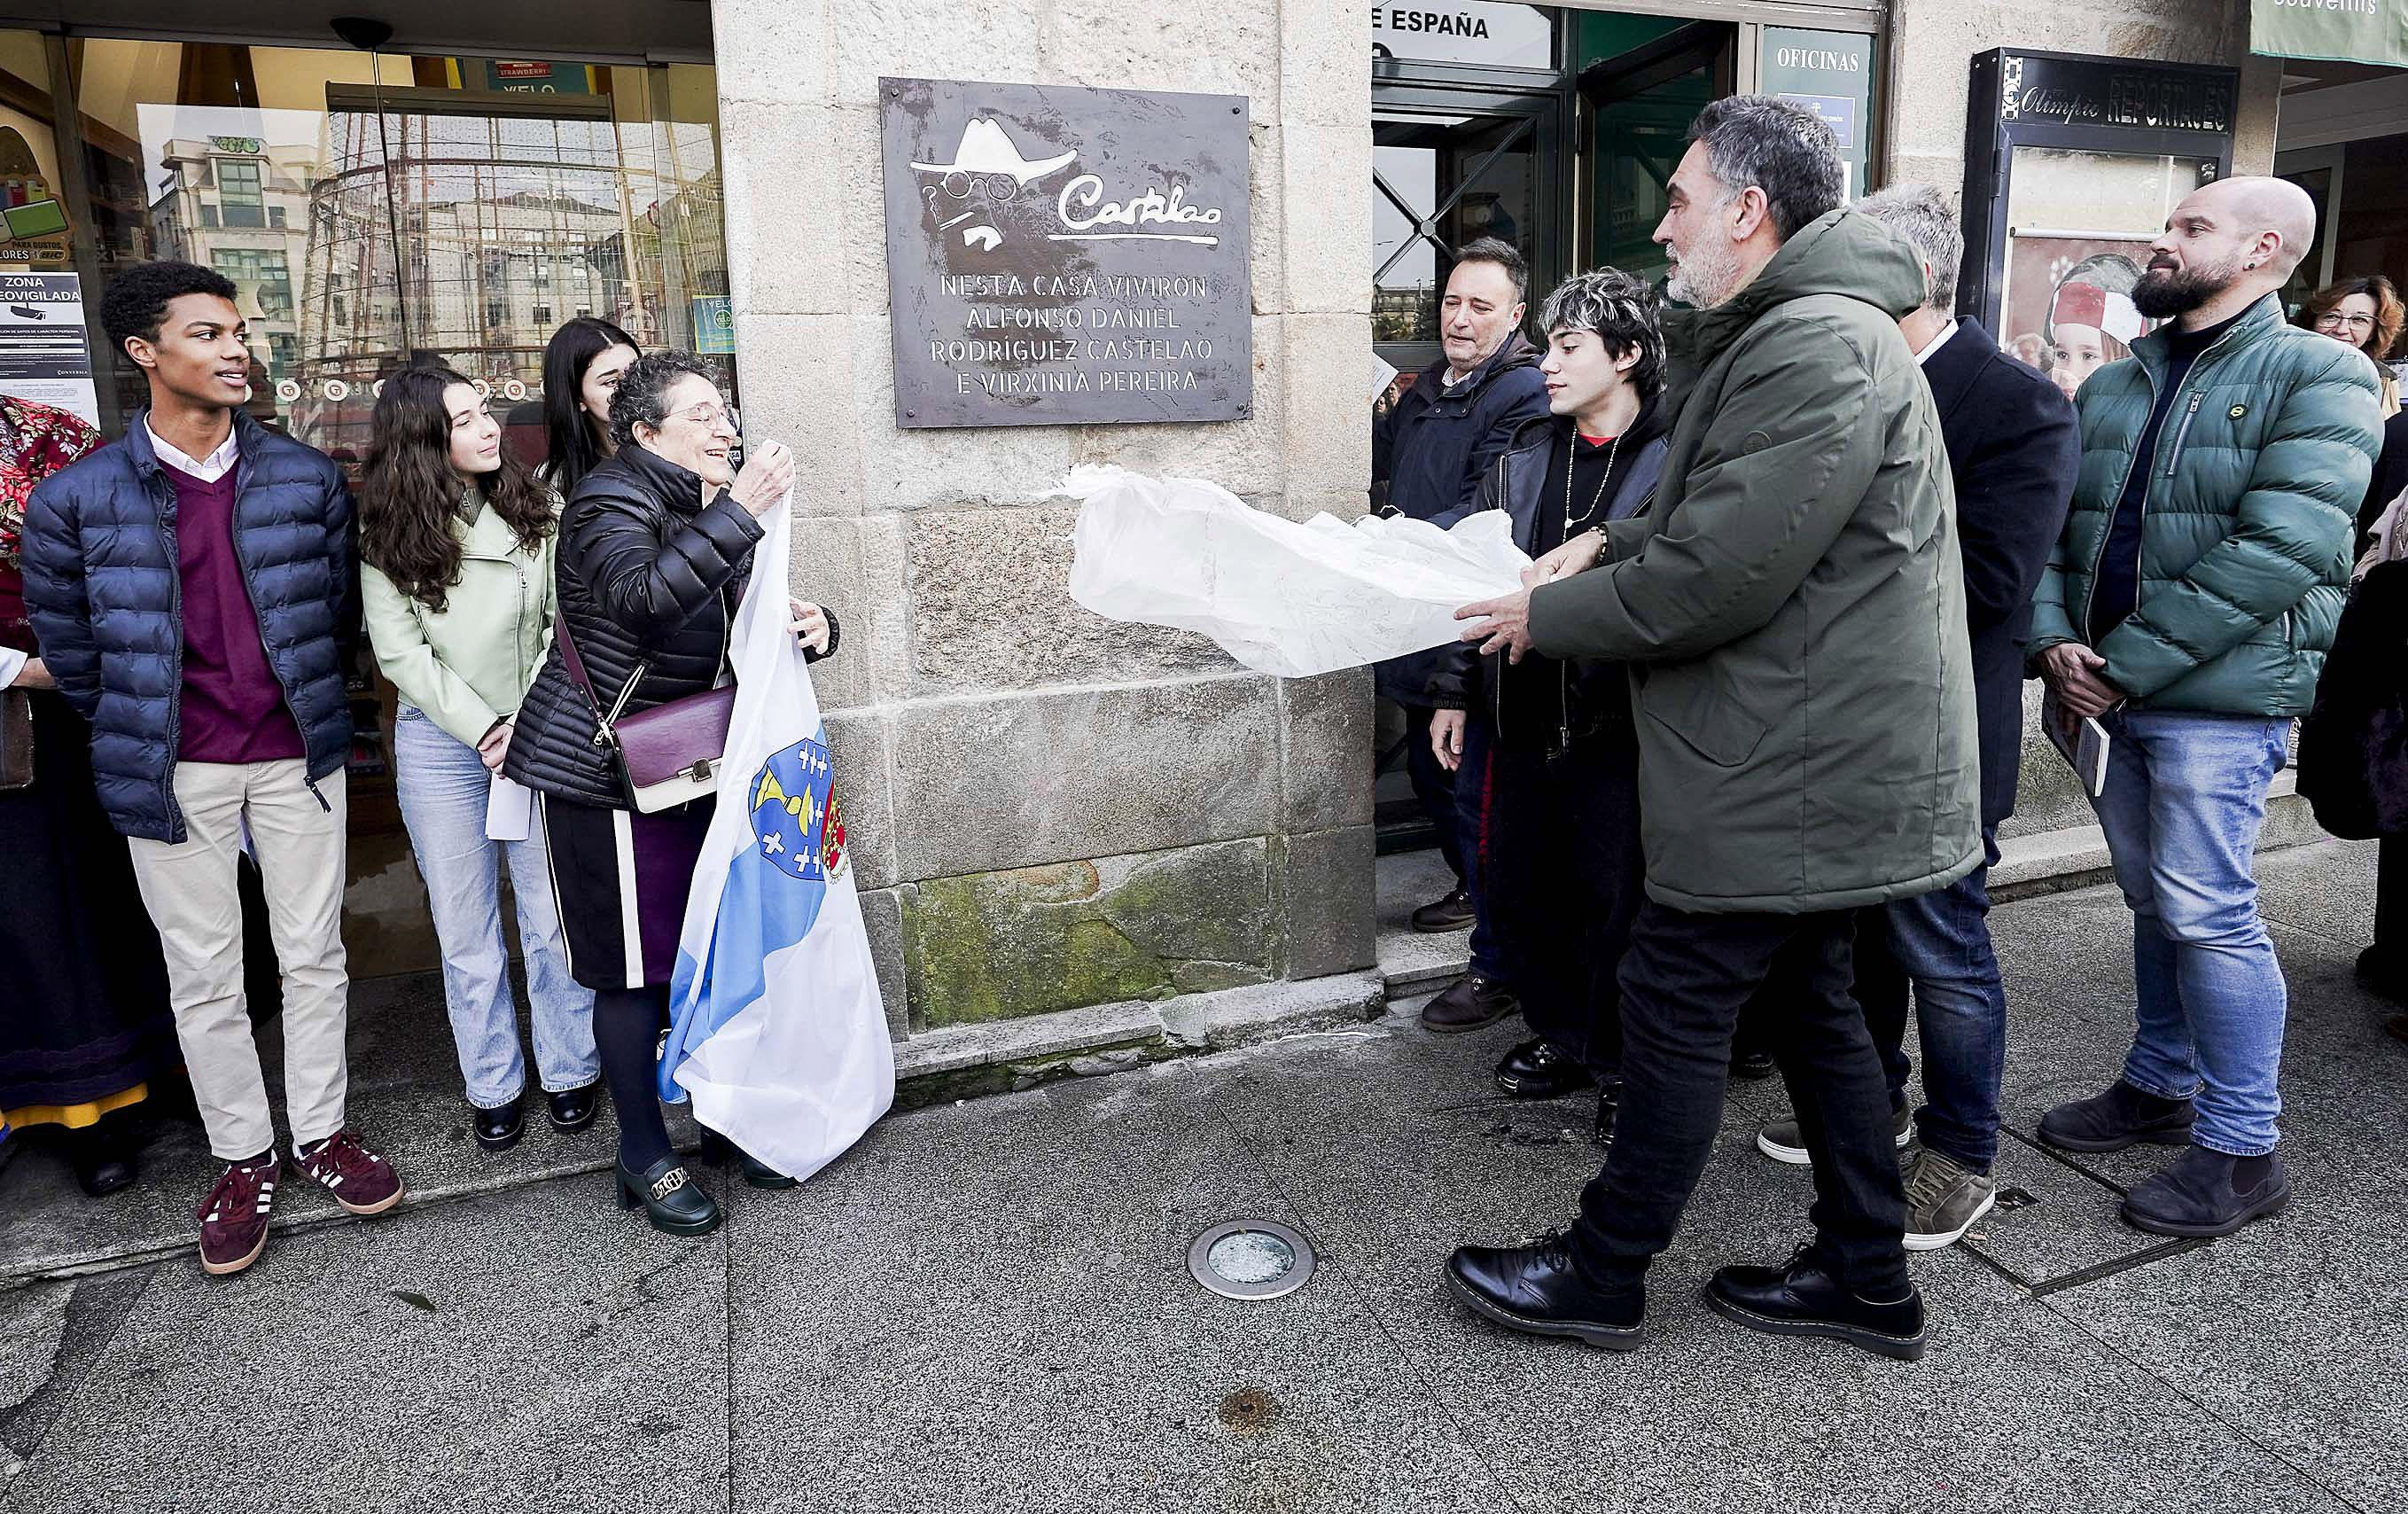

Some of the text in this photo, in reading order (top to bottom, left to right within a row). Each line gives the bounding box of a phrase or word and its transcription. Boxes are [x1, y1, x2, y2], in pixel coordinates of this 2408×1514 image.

[1391, 10, 1489, 39] ESPAÑA
[1777, 48, 1859, 72] OFICINAS
[1058, 173, 1222, 230] Castelao
[4, 277, 45, 287] ZONA
[940, 275, 1206, 298] NESTA CASA VIVIRON
[966, 307, 1181, 330] ALFONSO DANIEL
[931, 335, 1213, 362] RODRÍGUEZ CASTELAO
[957, 371, 1198, 394] E VIRXINIA PEREIRA
